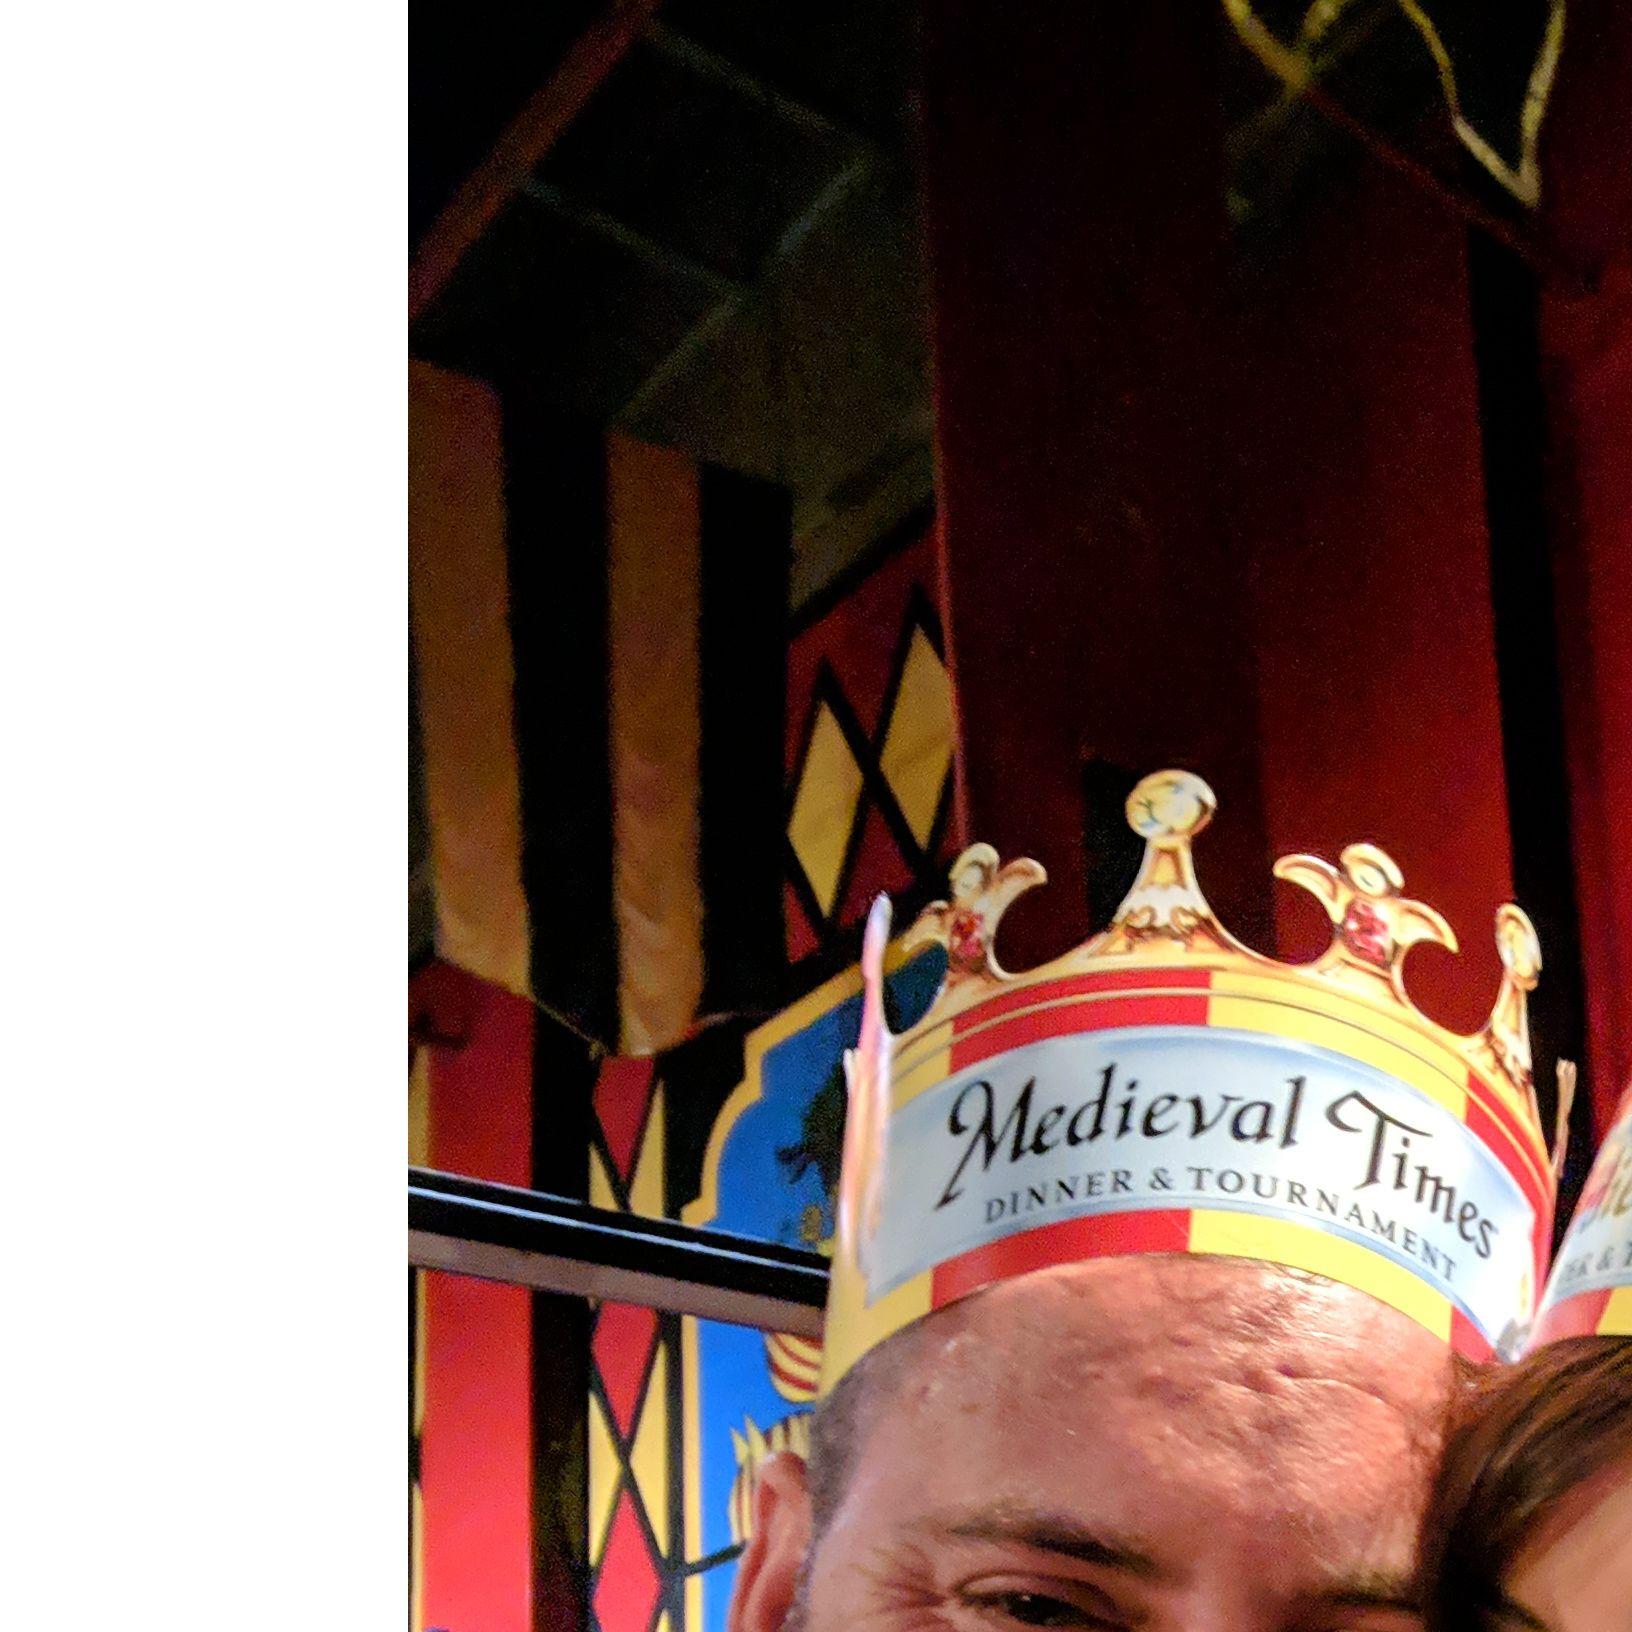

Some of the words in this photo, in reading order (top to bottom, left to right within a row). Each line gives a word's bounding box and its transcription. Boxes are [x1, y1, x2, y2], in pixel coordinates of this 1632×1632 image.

[934, 1062, 1306, 1212] Medieval
[1325, 1089, 1499, 1262] Times
[985, 1166, 1133, 1225] DINNER
[1148, 1166, 1175, 1192] &
[1191, 1165, 1459, 1283] TOURNAMENT
